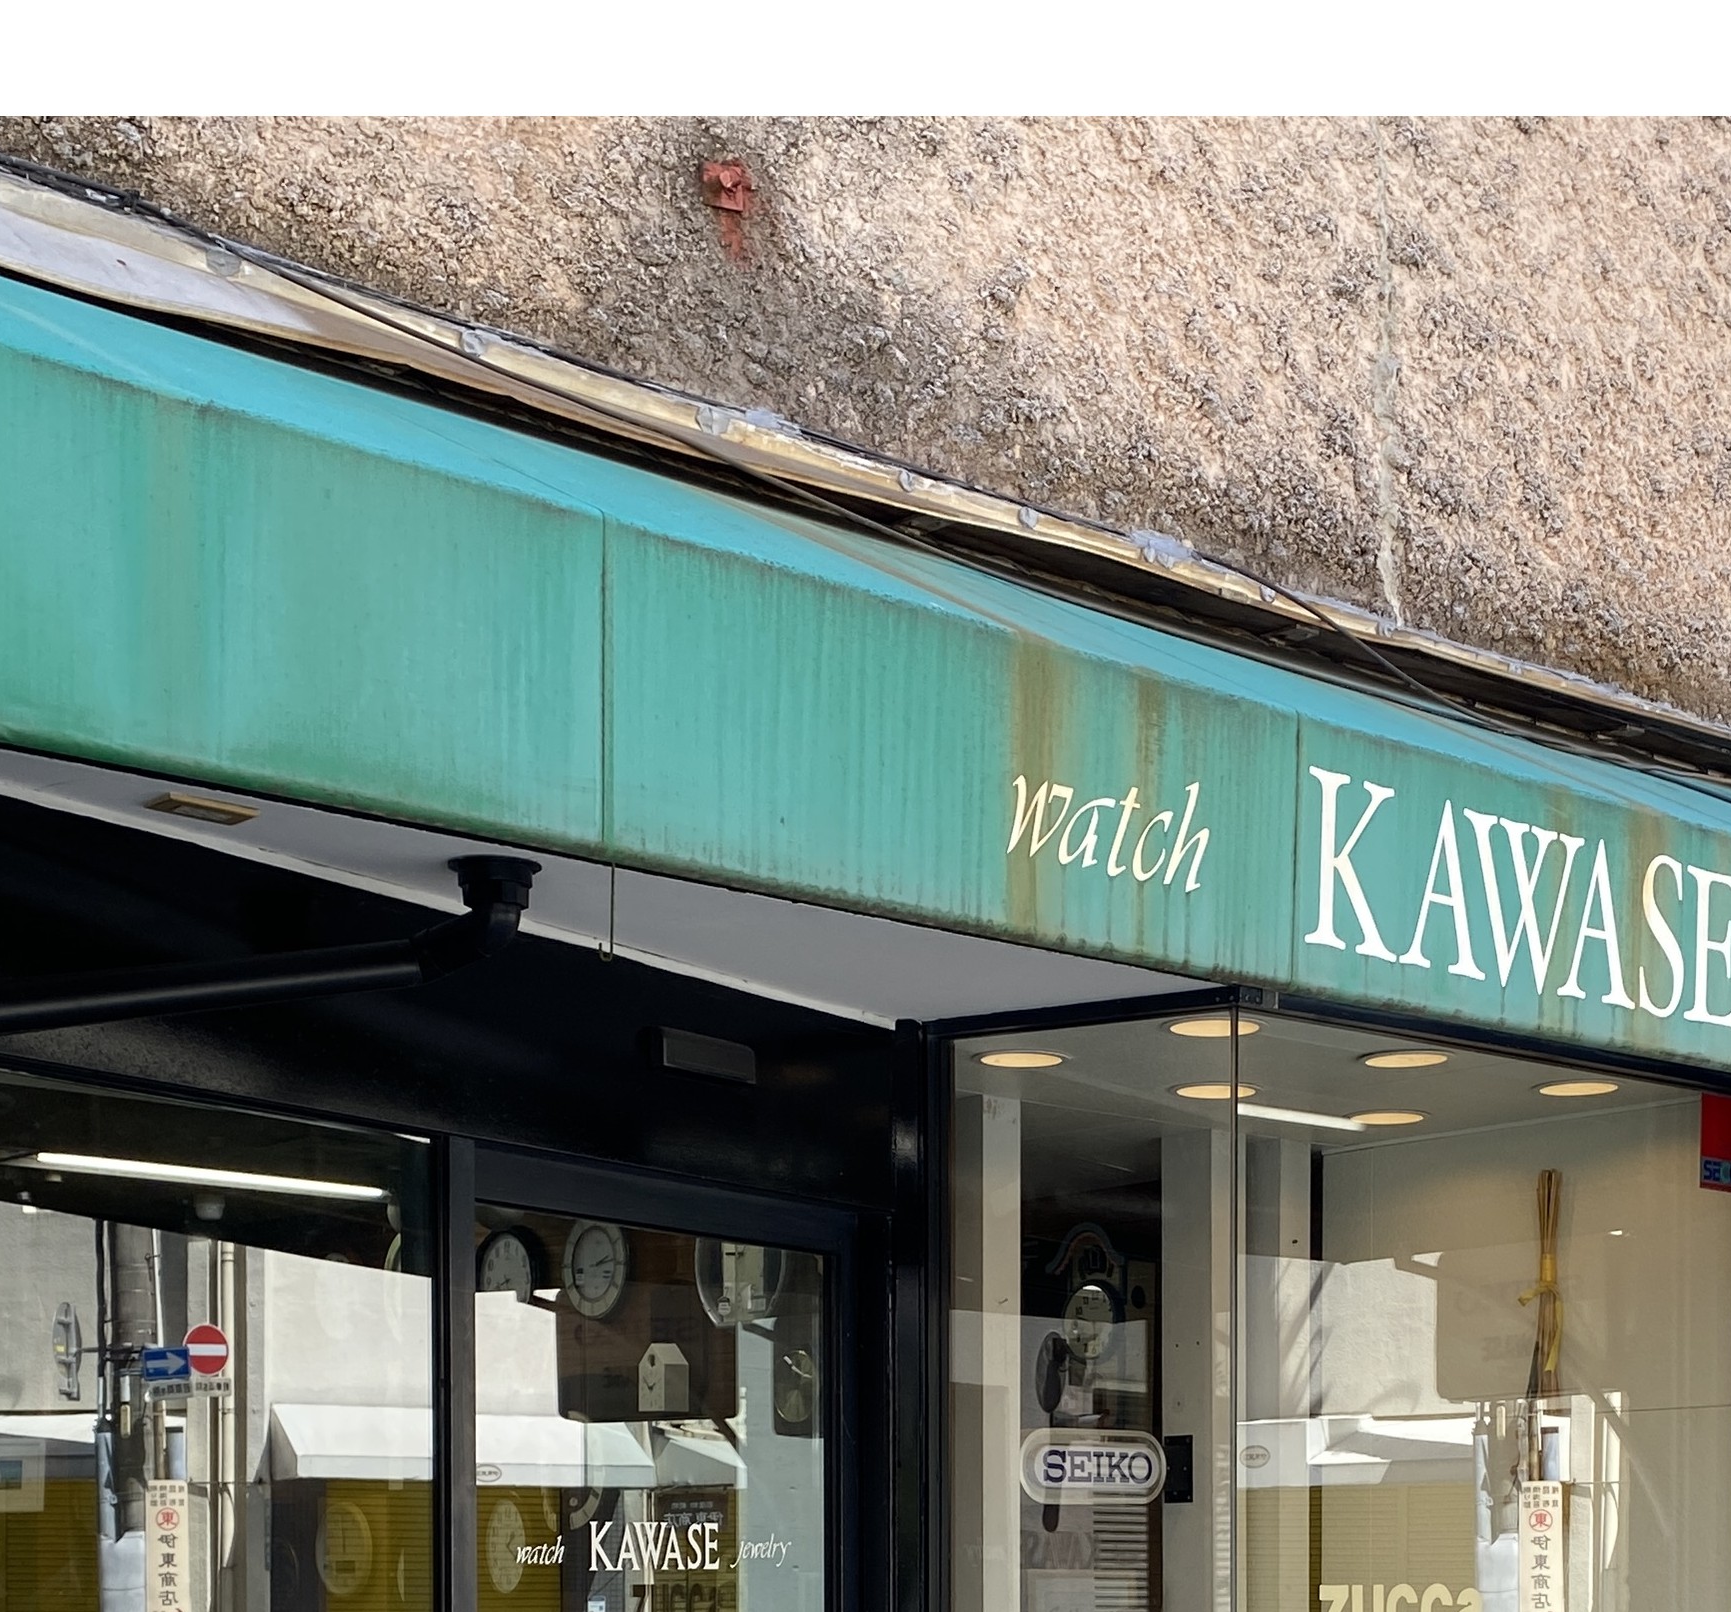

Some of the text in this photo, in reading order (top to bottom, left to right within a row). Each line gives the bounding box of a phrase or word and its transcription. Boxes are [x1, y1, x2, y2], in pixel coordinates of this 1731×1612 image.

[1004, 772, 1211, 892] watch
[1042, 1448, 1153, 1485] SEIKO
[515, 1520, 792, 1572] watch KAWASE jewelry
